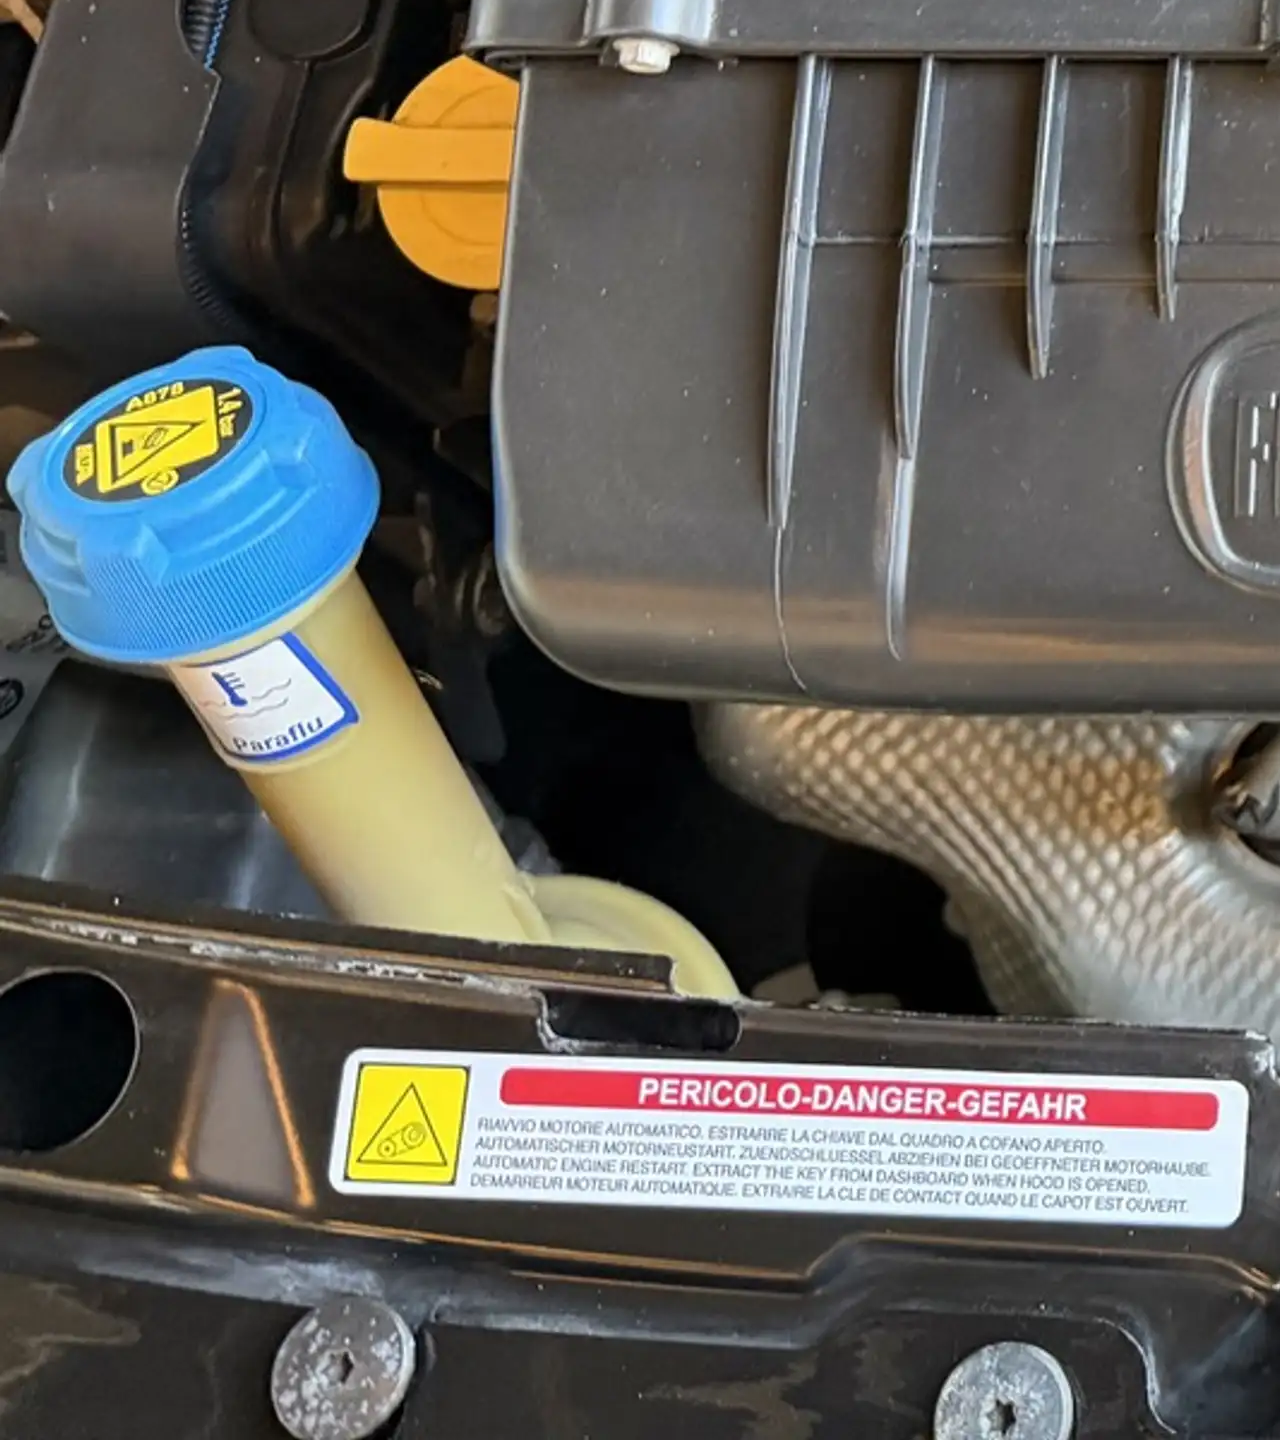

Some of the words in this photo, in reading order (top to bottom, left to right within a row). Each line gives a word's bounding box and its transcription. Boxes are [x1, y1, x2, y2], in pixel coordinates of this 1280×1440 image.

[232, 716, 324, 752] Paraflu
[638, 1077, 1087, 1120] PERICOLO-DANGER-GEFAHR
[477, 1117, 536, 1133] RIAVVIO
[539, 1119, 602, 1135] MOTORE
[605, 1122, 704, 1140] AUTOMATICO.
[708, 1125, 788, 1142] ESTRARRE
[791, 1128, 809, 1143] LA
[811, 1129, 865, 1145] CHIAVE
[869, 1131, 897, 1146] DAL
[900, 1132, 962, 1150] QUADRO
[979, 1137, 1041, 1152] COFANO
[1043, 1138, 1107, 1153] APERTO.
[475, 1136, 600, 1154] AUTOMATISCHER
[603, 1140, 735, 1159] MOTORNEUSTART.
[739, 1145, 884, 1165] ZUENDSCHLUESSEL
[888, 1152, 960, 1167] ABZIEHEN
[964, 1154, 988, 1168] BEI
[991, 1155, 1100, 1173] GEOEFFNETER
[470, 1173, 563, 1191] DEMARREUR
[566, 1176, 629, 1192] MOTEUR
[631, 1178, 738, 1197] AUTOMATIQUE.
[741, 1183, 814, 1199] EXTRAIRE
[817, 1186, 836, 1201] LA
[838, 1186, 866, 1202] CLE
[869, 1188, 891, 1202] DE
[893, 1190, 962, 1206] CONTACT
[964, 1192, 1018, 1208] QUAND
[1020, 1194, 1039, 1209] LE
[1041, 1195, 1092, 1211] CAPOT
[1094, 1196, 1125, 1211] EST
[1126, 1198, 1189, 1214] OUVERT.
[473, 1155, 557, 1171] AUTOMATIC
[561, 1157, 616, 1173] ENGINE
[620, 1160, 686, 1175] RESTART.
[692, 1162, 761, 1179] EXTRACT
[765, 1165, 793, 1180] THE
[797, 1166, 827, 1181] KEY
[830, 1167, 873, 1183] FROM
[876, 1169, 968, 1187] DASHBOARD
[972, 1172, 1017, 1188] WHEN
[1067, 1176, 1082, 1191] IS
[1085, 1177, 1151, 1194] OPENED.
